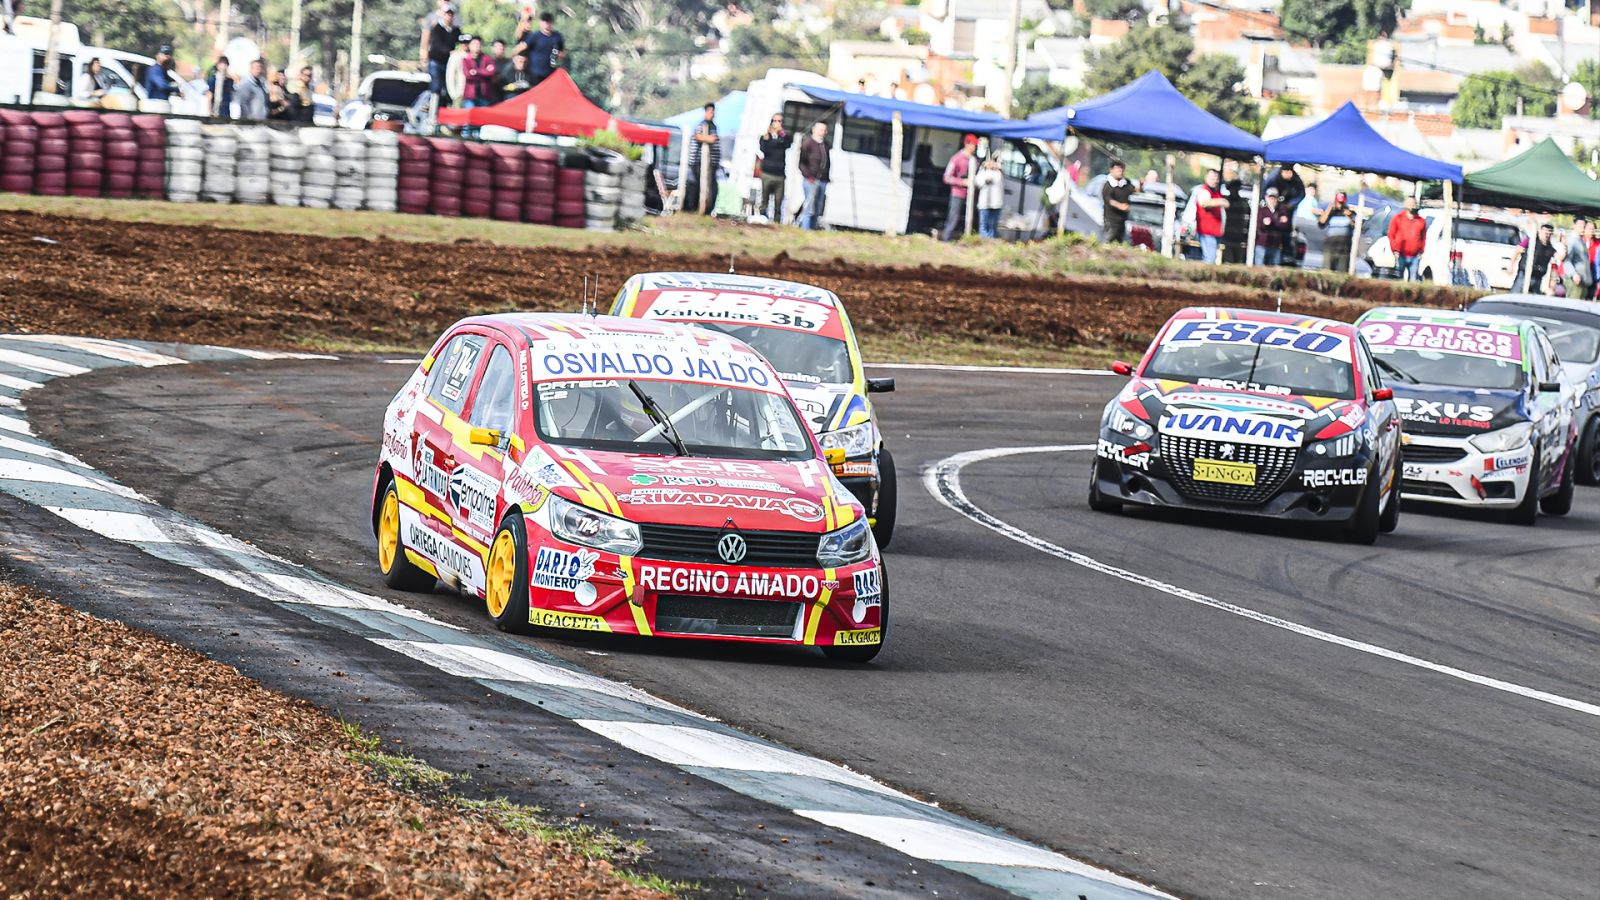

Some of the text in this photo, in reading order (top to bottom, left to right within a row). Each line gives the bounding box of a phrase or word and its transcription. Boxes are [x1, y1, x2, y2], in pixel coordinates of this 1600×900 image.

[770, 312, 815, 329] 3b
[1170, 321, 1342, 353] ESCO
[1394, 335, 1513, 357] SEGUROS
[1399, 324, 1512, 346] SANCOR
[543, 352, 770, 388] OSVALDO JALDO
[537, 379, 620, 392] ORTEGA
[633, 492, 789, 511] RIVADAVIA
[409, 522, 439, 560] ORTEGA
[438, 541, 473, 580] CAMIONES
[536, 548, 581, 578] DARIO
[640, 565, 819, 599] REGINO AMADO
[529, 609, 600, 630] LA GACETA
[840, 631, 855, 644] LA
